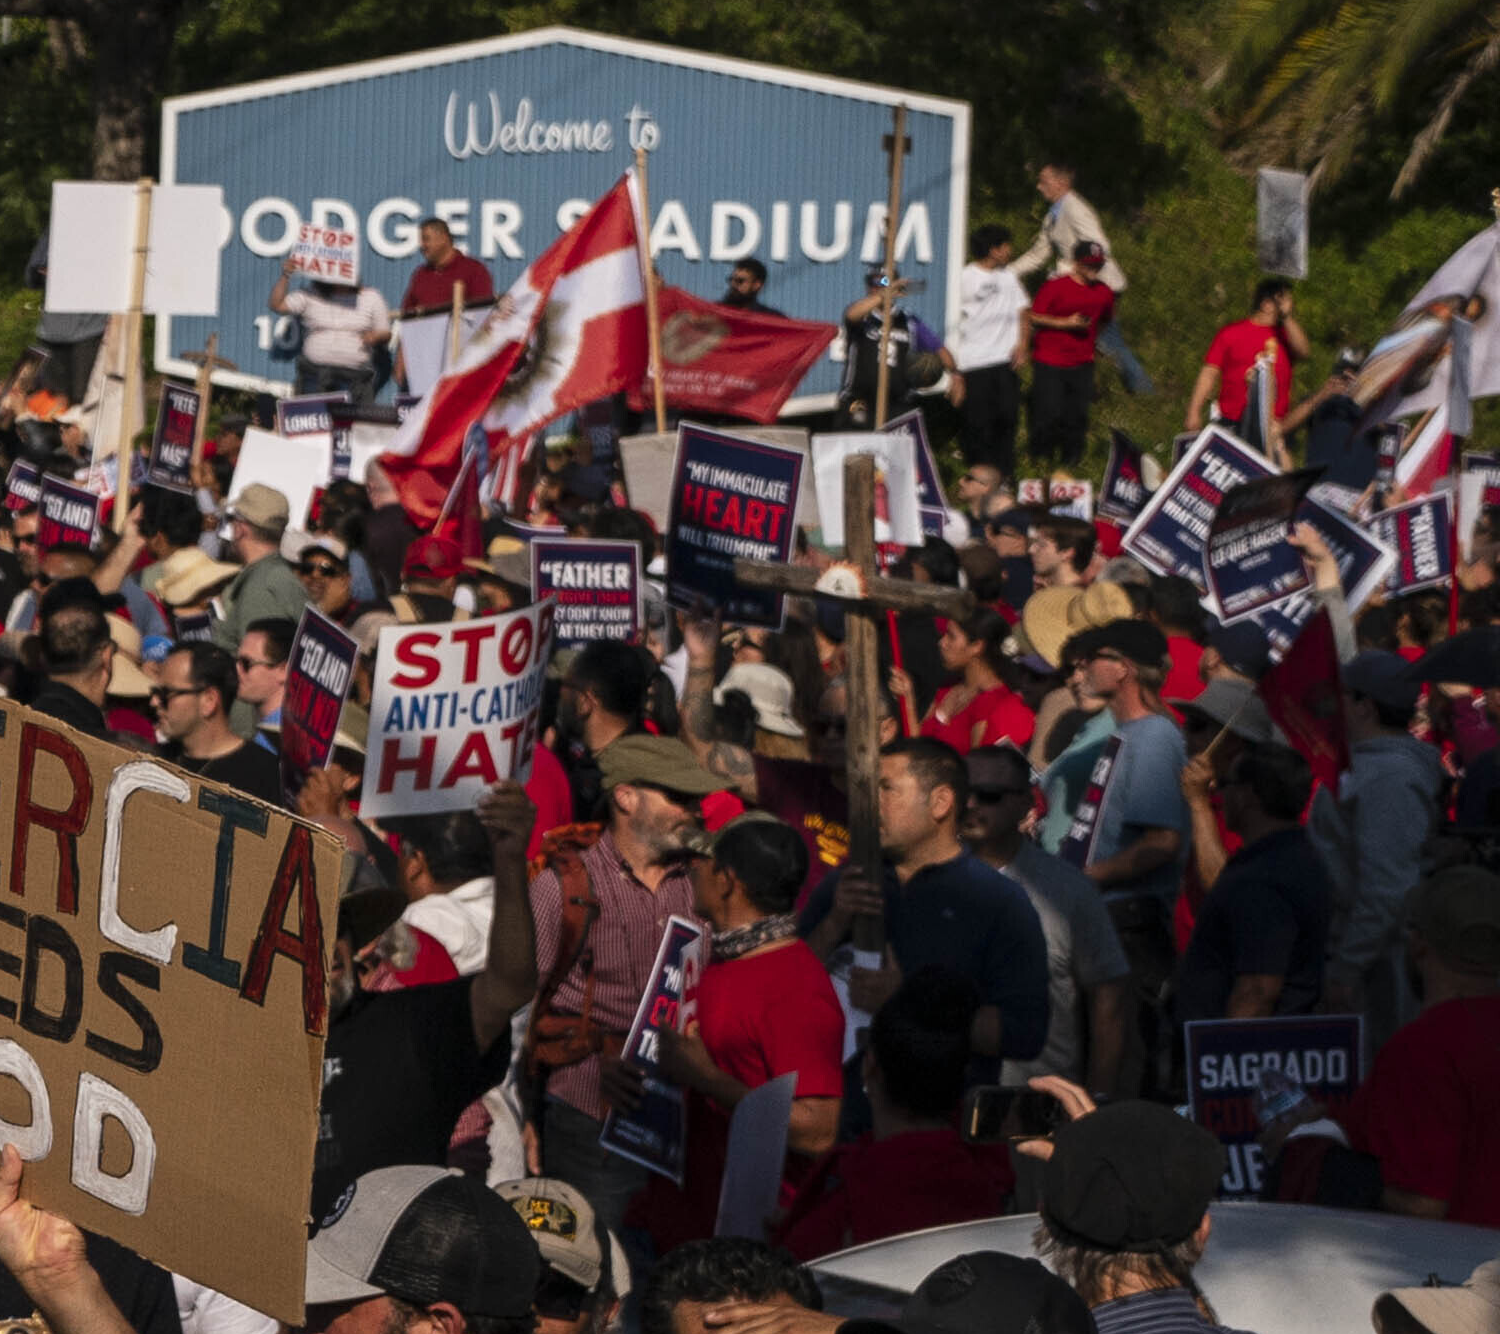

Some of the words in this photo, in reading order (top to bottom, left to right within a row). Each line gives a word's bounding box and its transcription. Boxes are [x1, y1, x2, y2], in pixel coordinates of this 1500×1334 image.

[444, 88, 613, 159] Welcome
[624, 103, 661, 151] to
[300, 224, 354, 248] STOP
[293, 256, 354, 279] HATE
[710, 469, 790, 501] IMMACULATE
[682, 485, 789, 543] HEART
[539, 560, 632, 589] “FATHER
[390, 604, 556, 689] STOP
[1200, 1047, 1348, 1089] SAGRADO
